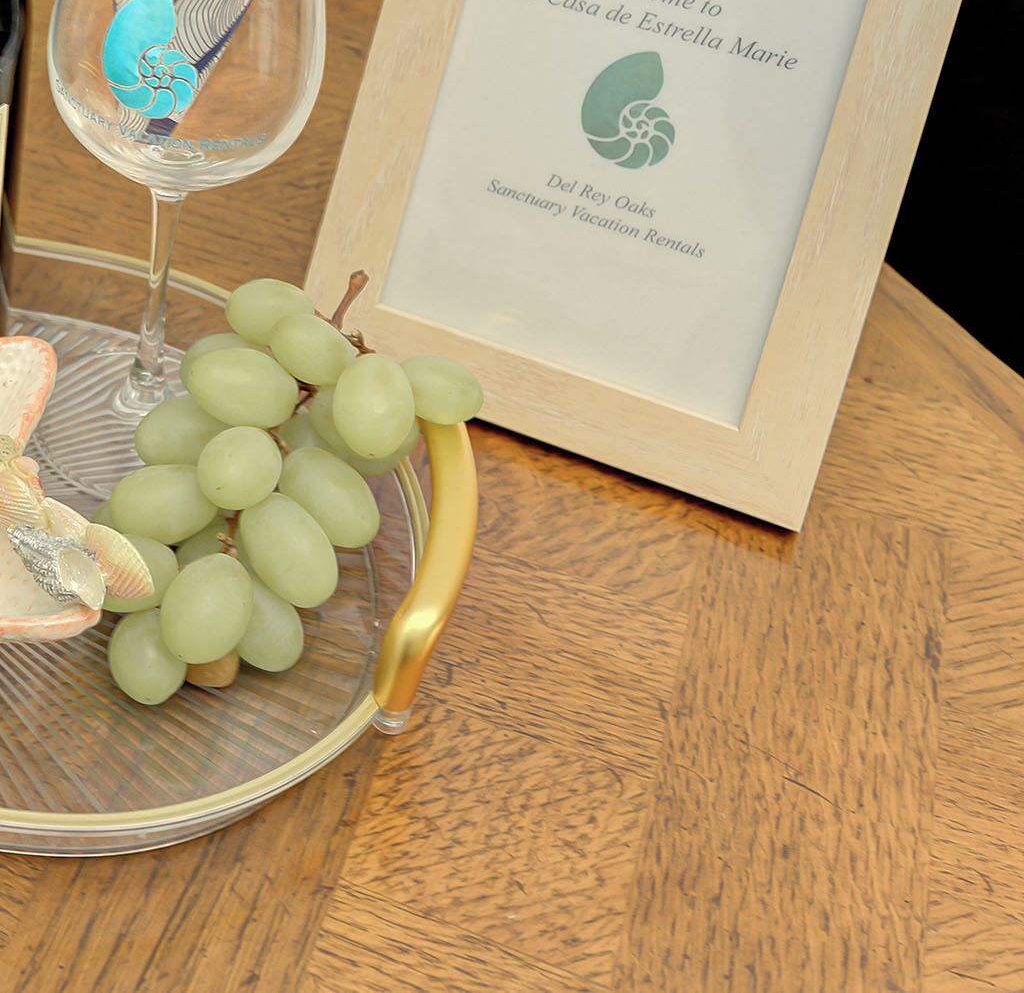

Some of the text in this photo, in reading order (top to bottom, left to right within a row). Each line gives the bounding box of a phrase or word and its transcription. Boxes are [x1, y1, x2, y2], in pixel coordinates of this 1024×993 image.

[701, 0, 723, 17] to
[605, 5, 632, 24] de
[637, 13, 723, 50] Estrella
[728, 37, 799, 70] Marie
[487, 178, 706, 259] Sanctuary Vacation Rentals
[546, 174, 657, 219] Del Rey Oaks
